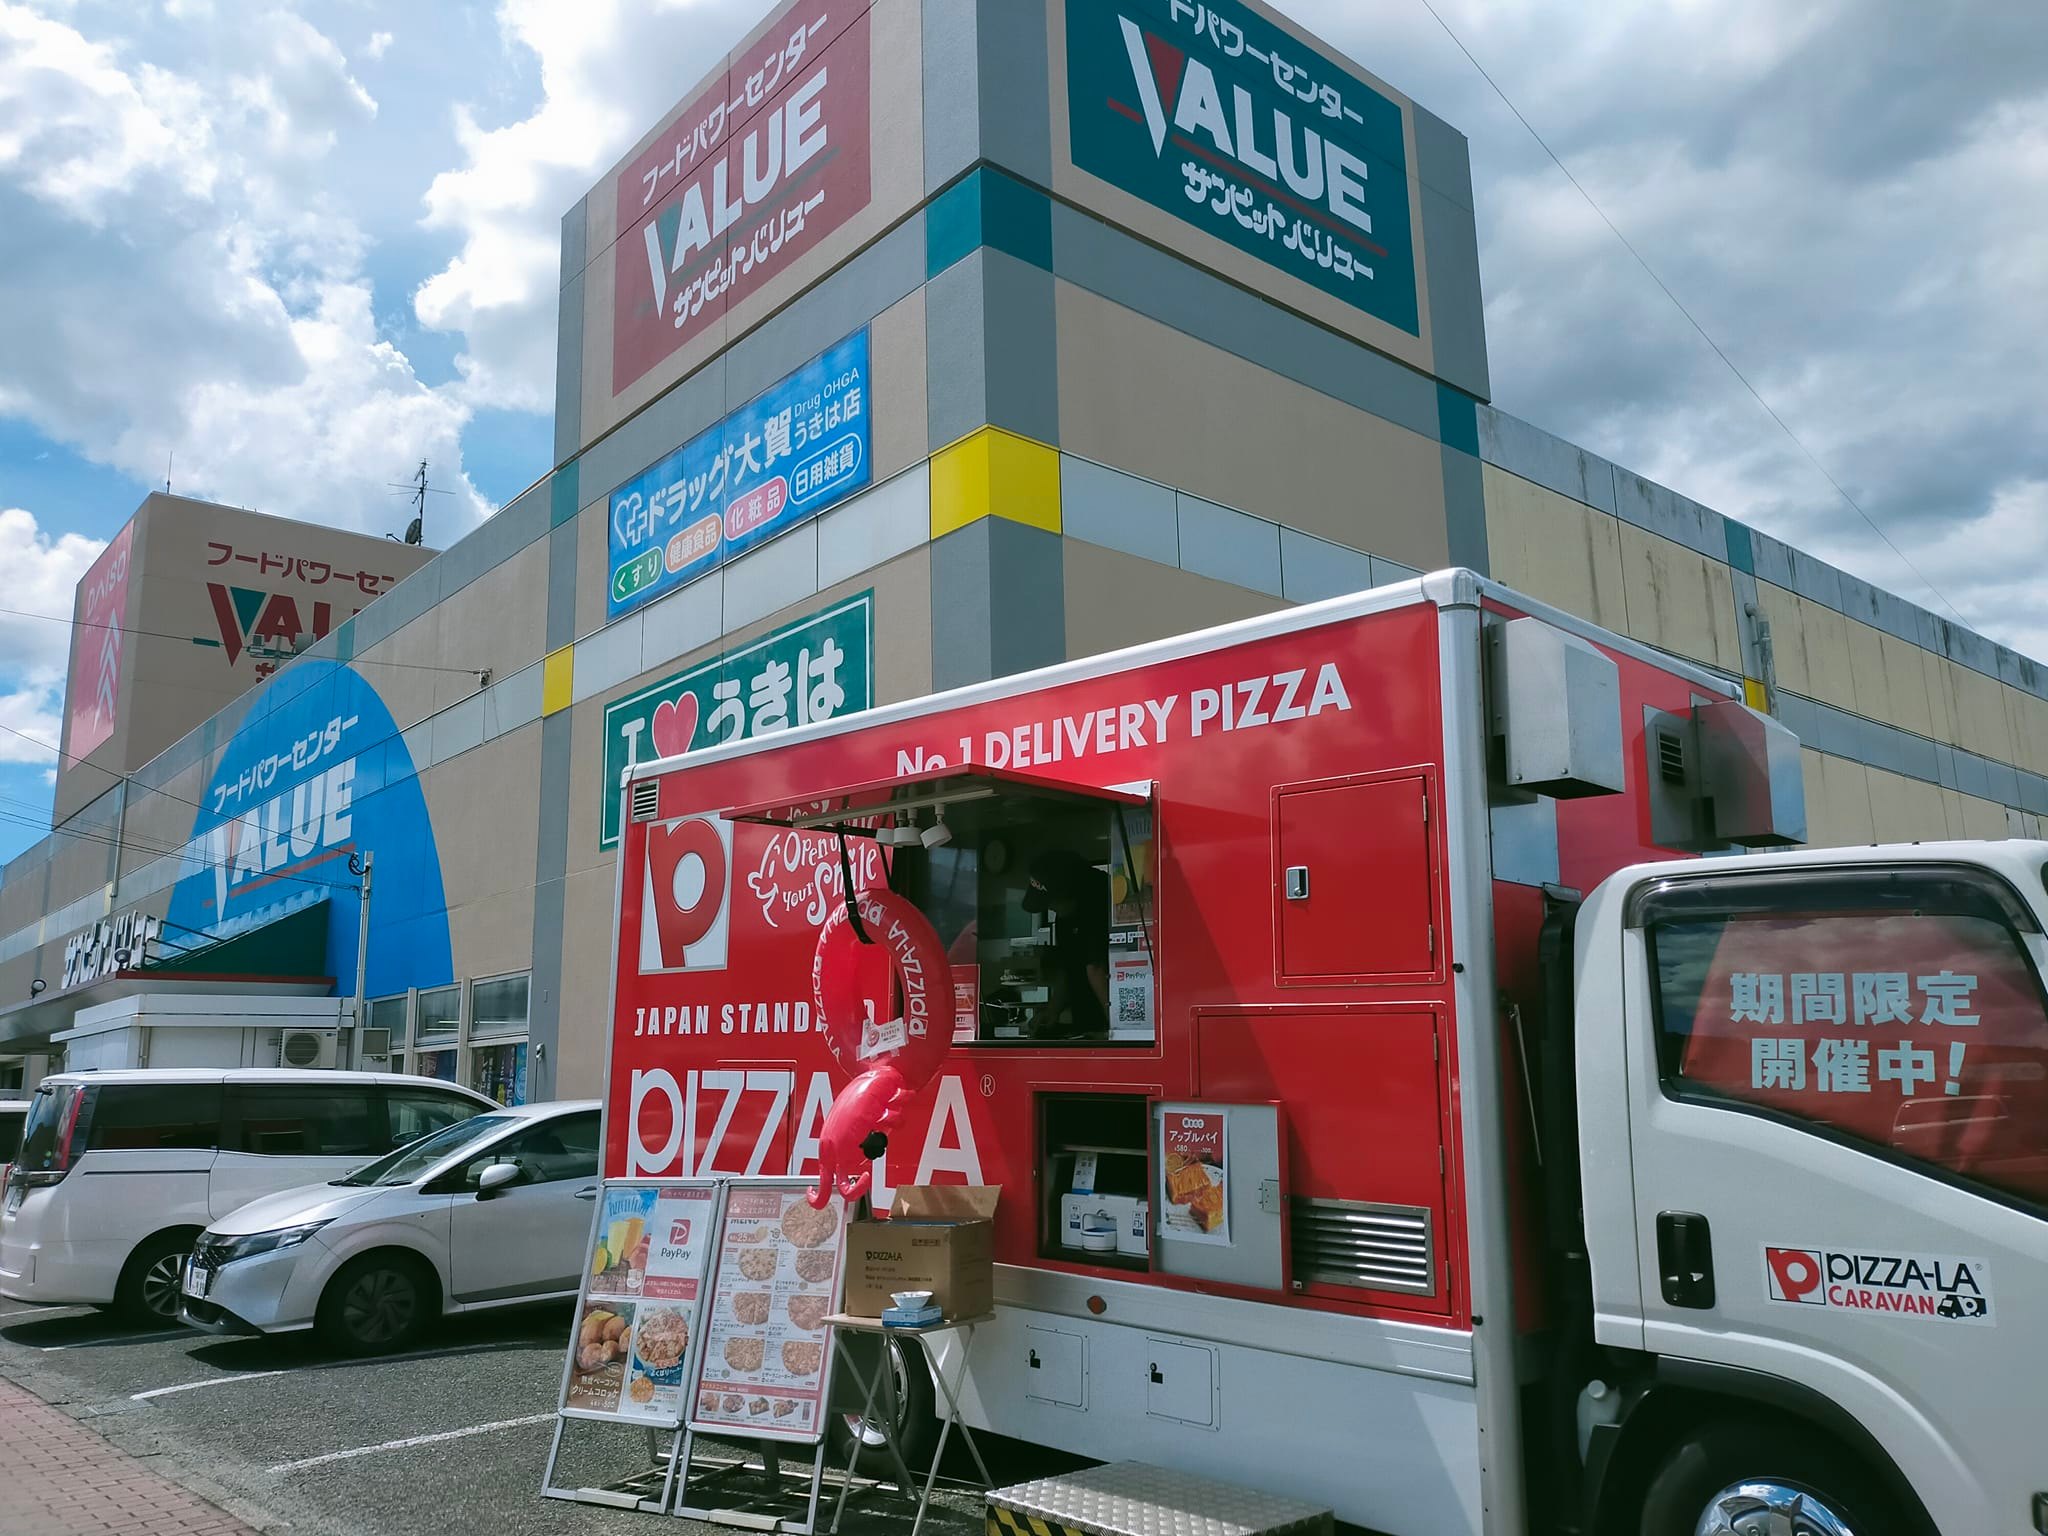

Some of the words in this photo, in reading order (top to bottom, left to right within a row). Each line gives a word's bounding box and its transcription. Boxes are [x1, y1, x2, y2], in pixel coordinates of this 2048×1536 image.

[643, 13, 827, 205] フードパワーセンター
[1117, 14, 1372, 234] VALUE
[643, 66, 828, 320] VALUE
[794, 393, 821, 418] Drug
[823, 368, 859, 400] OHGA
[794, 387, 861, 450] うきは店
[650, 406, 793, 537] ドラッグ大賀
[795, 443, 855, 497] 日用雑貨
[730, 484, 781, 532] 化粧品
[617, 548, 658, 592] くすり
[669, 522, 717, 567] 健康食品
[88, 551, 127, 615] DAISO
[706, 637, 845, 746] うきは
[985, 695, 1179, 770] DELIVERY
[1191, 662, 1352, 737] PIZZA
[213, 714, 359, 815] フードパワーセンター
[201, 757, 358, 922] VALUE
[783, 831, 829, 873] Open
[782, 881, 815, 911] your
[806, 842, 877, 926] Smile
[1126, 971, 1147, 981] PayPay
[1730, 970, 1980, 1026] 期間限定
[634, 1006, 709, 1037] JAPAN
[1751, 1037, 1967, 1096] 開催中!
[1169, 1130, 1218, 1144] アップルパイ
[661, 1247, 691, 1260] PayPay
[1826, 1253, 1982, 1295] PIZZA-LA
[1828, 1285, 1935, 1316] CARAVAN
[572, 1384, 620, 1399] クリームコロッケ
